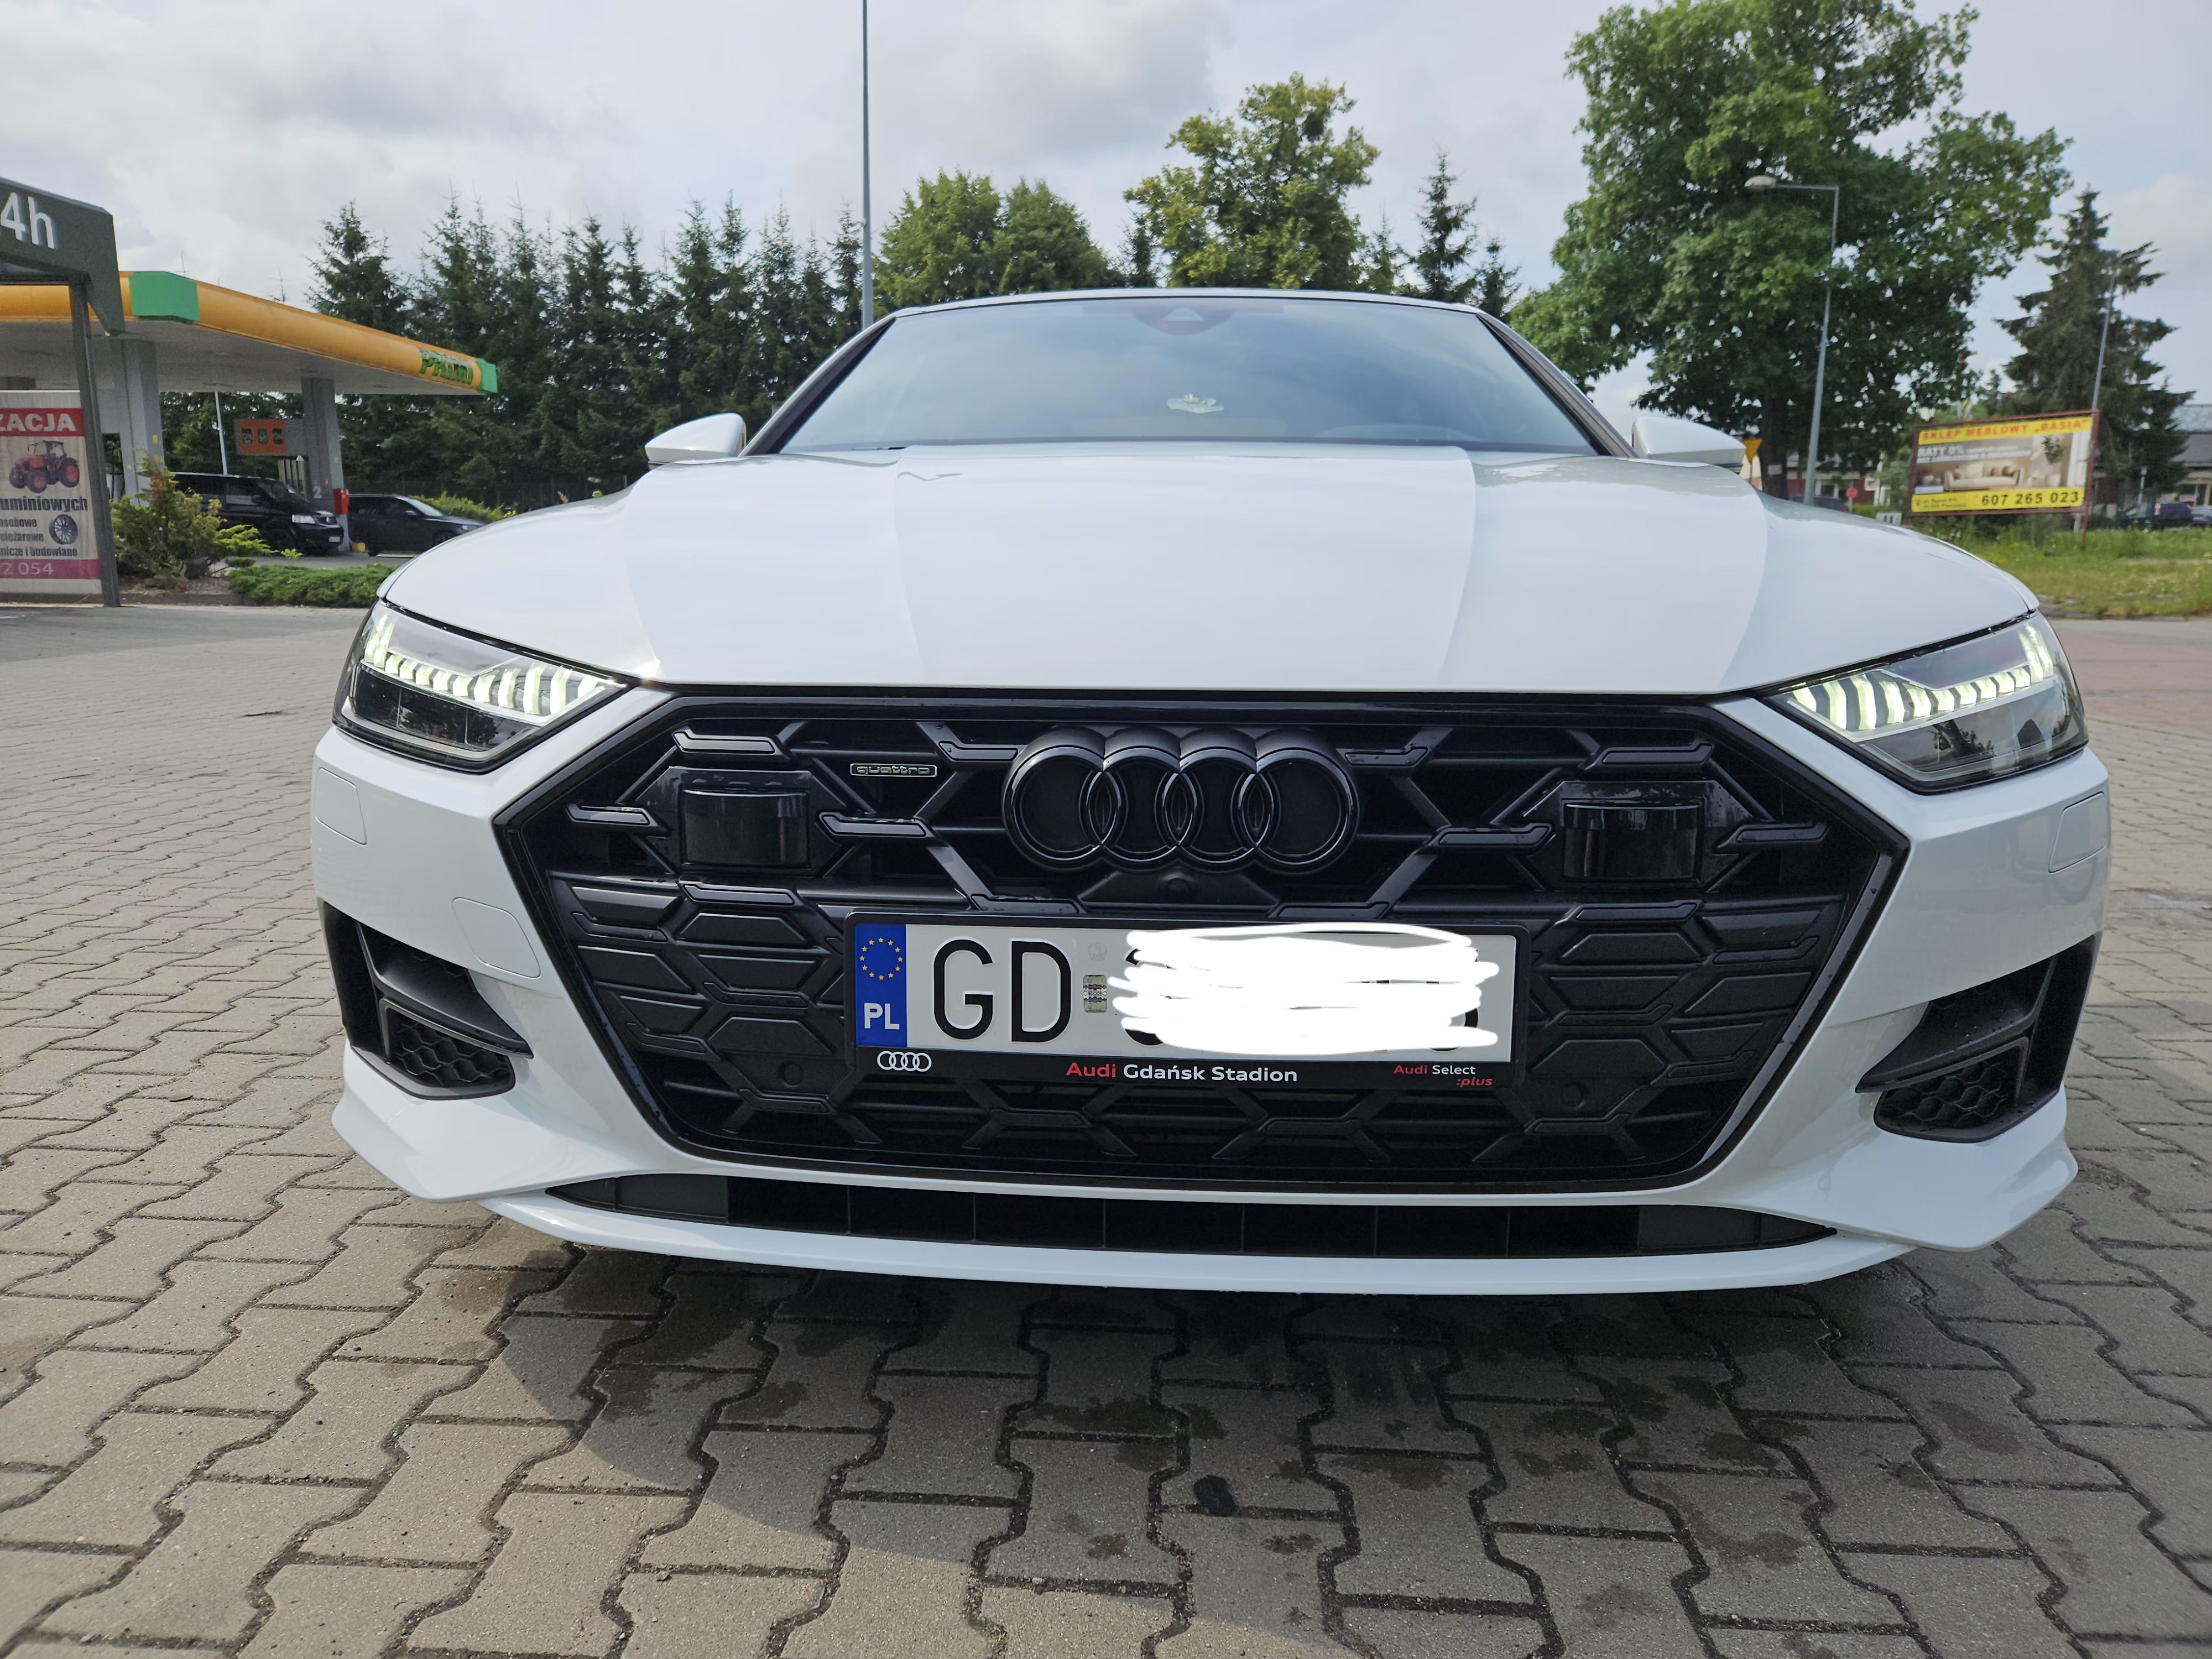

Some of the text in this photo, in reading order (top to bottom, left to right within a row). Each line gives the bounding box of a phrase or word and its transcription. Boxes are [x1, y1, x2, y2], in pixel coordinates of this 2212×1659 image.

[1, 192, 55, 249] 4h
[1923, 429, 1960, 440] SKLEP
[1966, 424, 2028, 437] MEBLOWY
[1982, 491, 2079, 506] 607 265 023
[18, 562, 53, 575] 054
[857, 765, 930, 775] quattro
[933, 938, 1072, 1042] GD
[864, 1003, 900, 1030] PL
[1066, 1062, 1297, 1082] Audi Gdańsk Stadion
[1394, 1065, 1476, 1074] Audi Select
